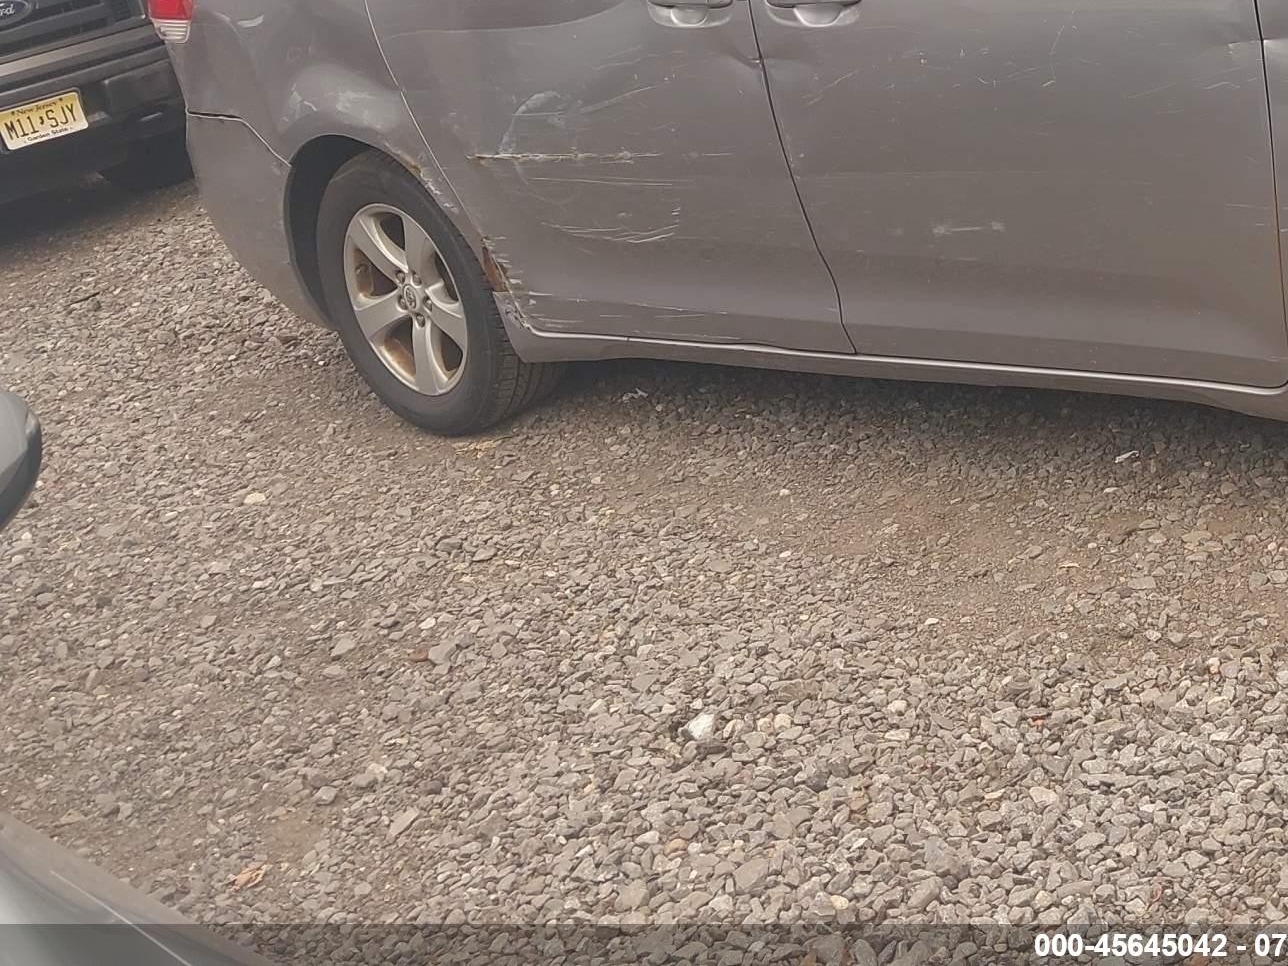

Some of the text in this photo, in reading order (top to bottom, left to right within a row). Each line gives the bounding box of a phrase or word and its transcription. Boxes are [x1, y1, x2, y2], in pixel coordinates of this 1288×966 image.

[16, 101, 58, 116] New Jersey
[27, 126, 69, 142] Garden State
